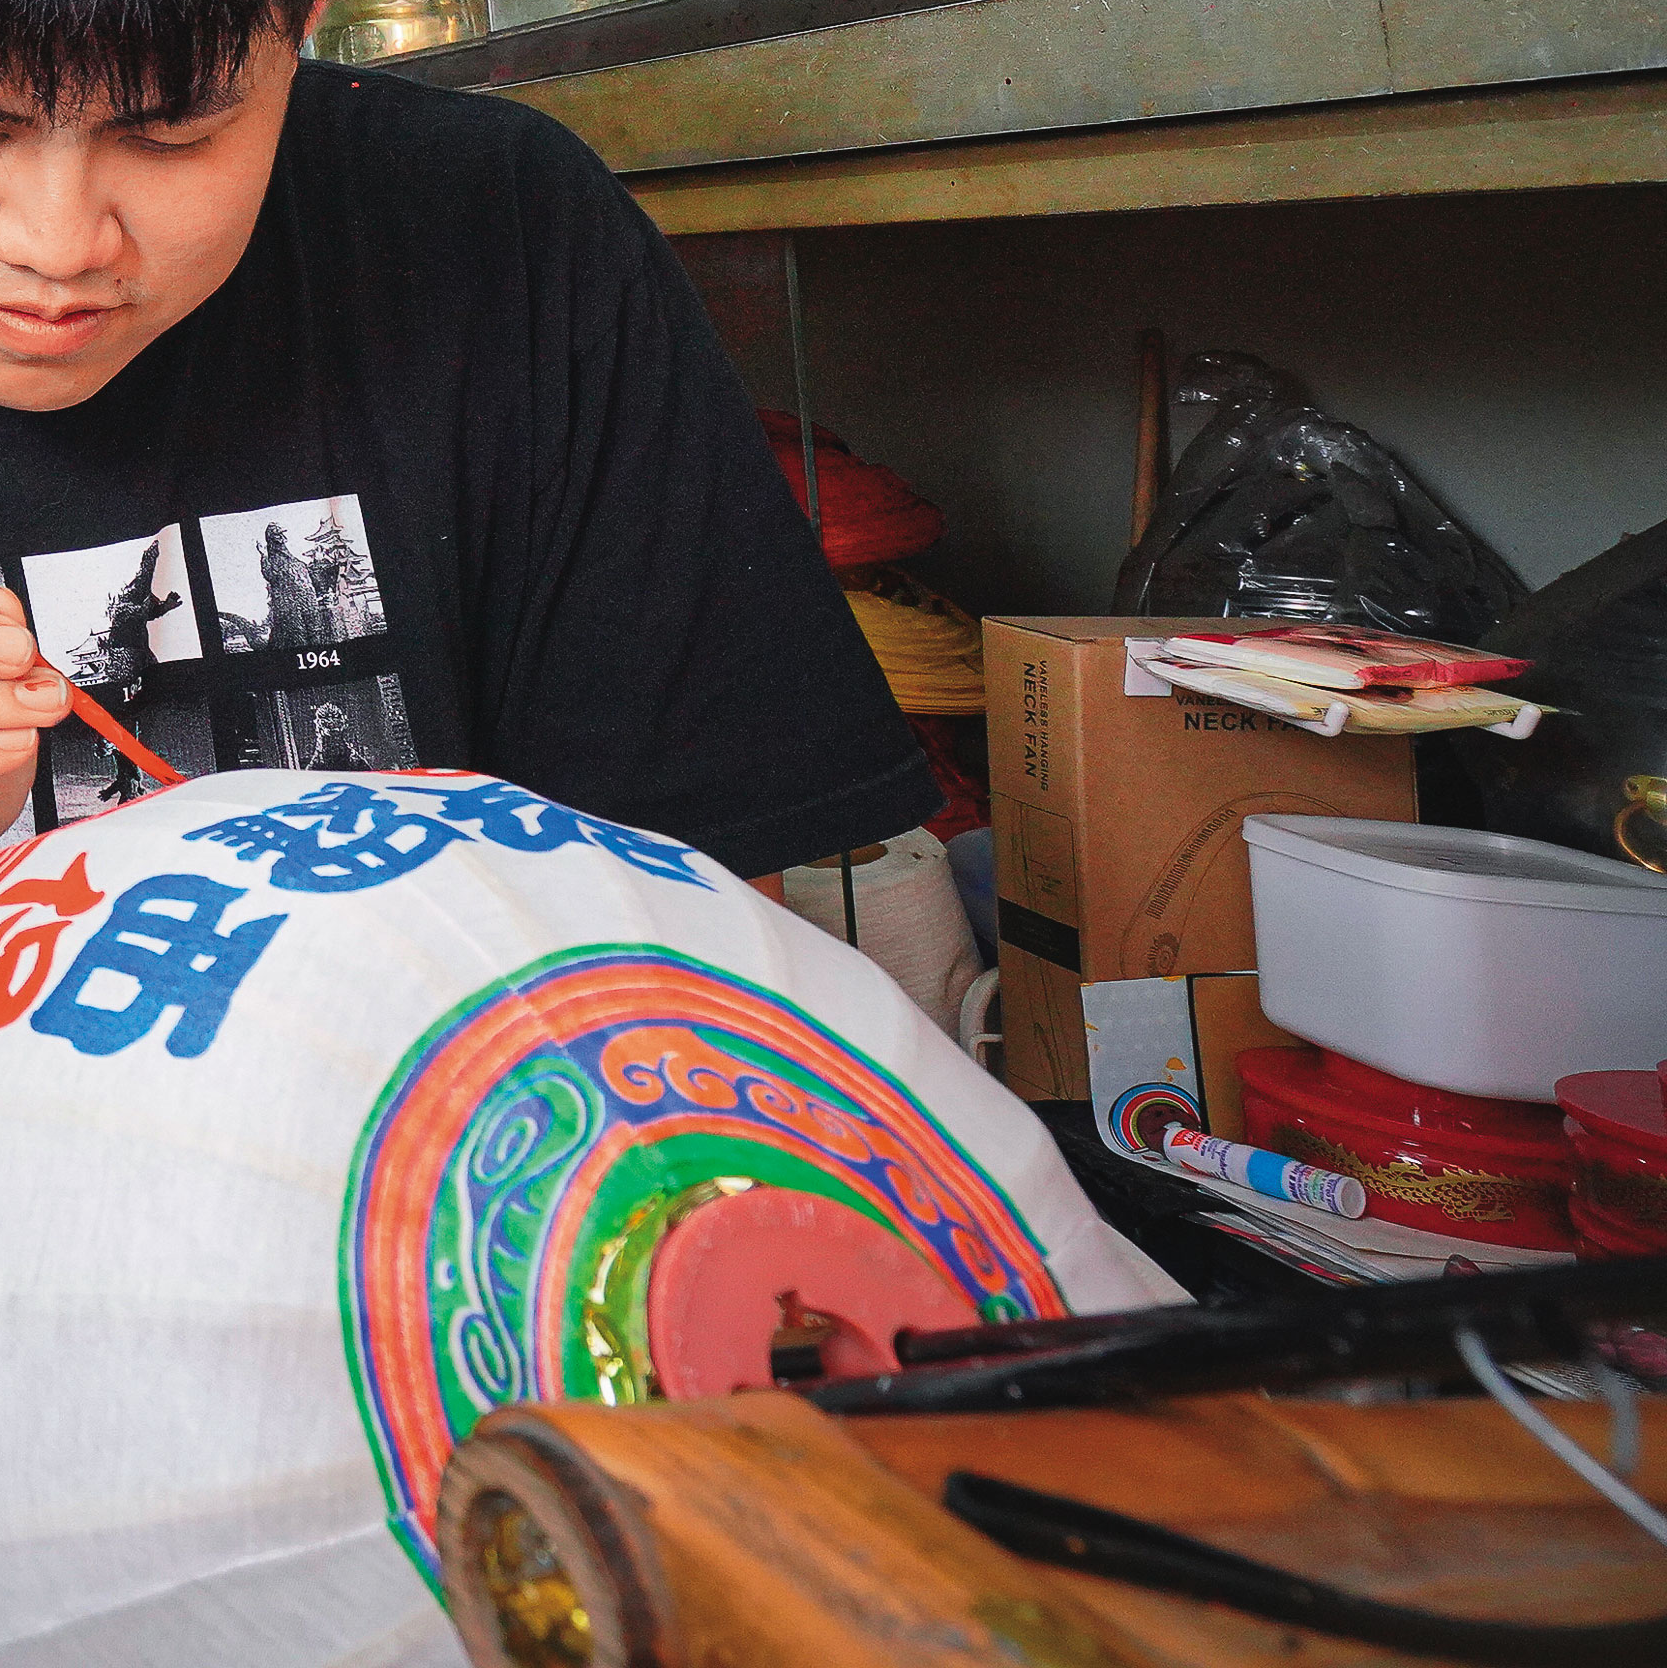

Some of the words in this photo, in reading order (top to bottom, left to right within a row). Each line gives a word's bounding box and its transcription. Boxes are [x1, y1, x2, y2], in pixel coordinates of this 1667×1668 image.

[296, 649, 341, 671] 1964
[1023, 662, 1037, 726] NECK
[1039, 659, 1049, 727] VANELESS
[1183, 711, 1255, 733] NECK
[1267, 713, 1302, 732] FA
[1024, 733, 1038, 778] FAN
[1040, 732, 1049, 791] HANGING
